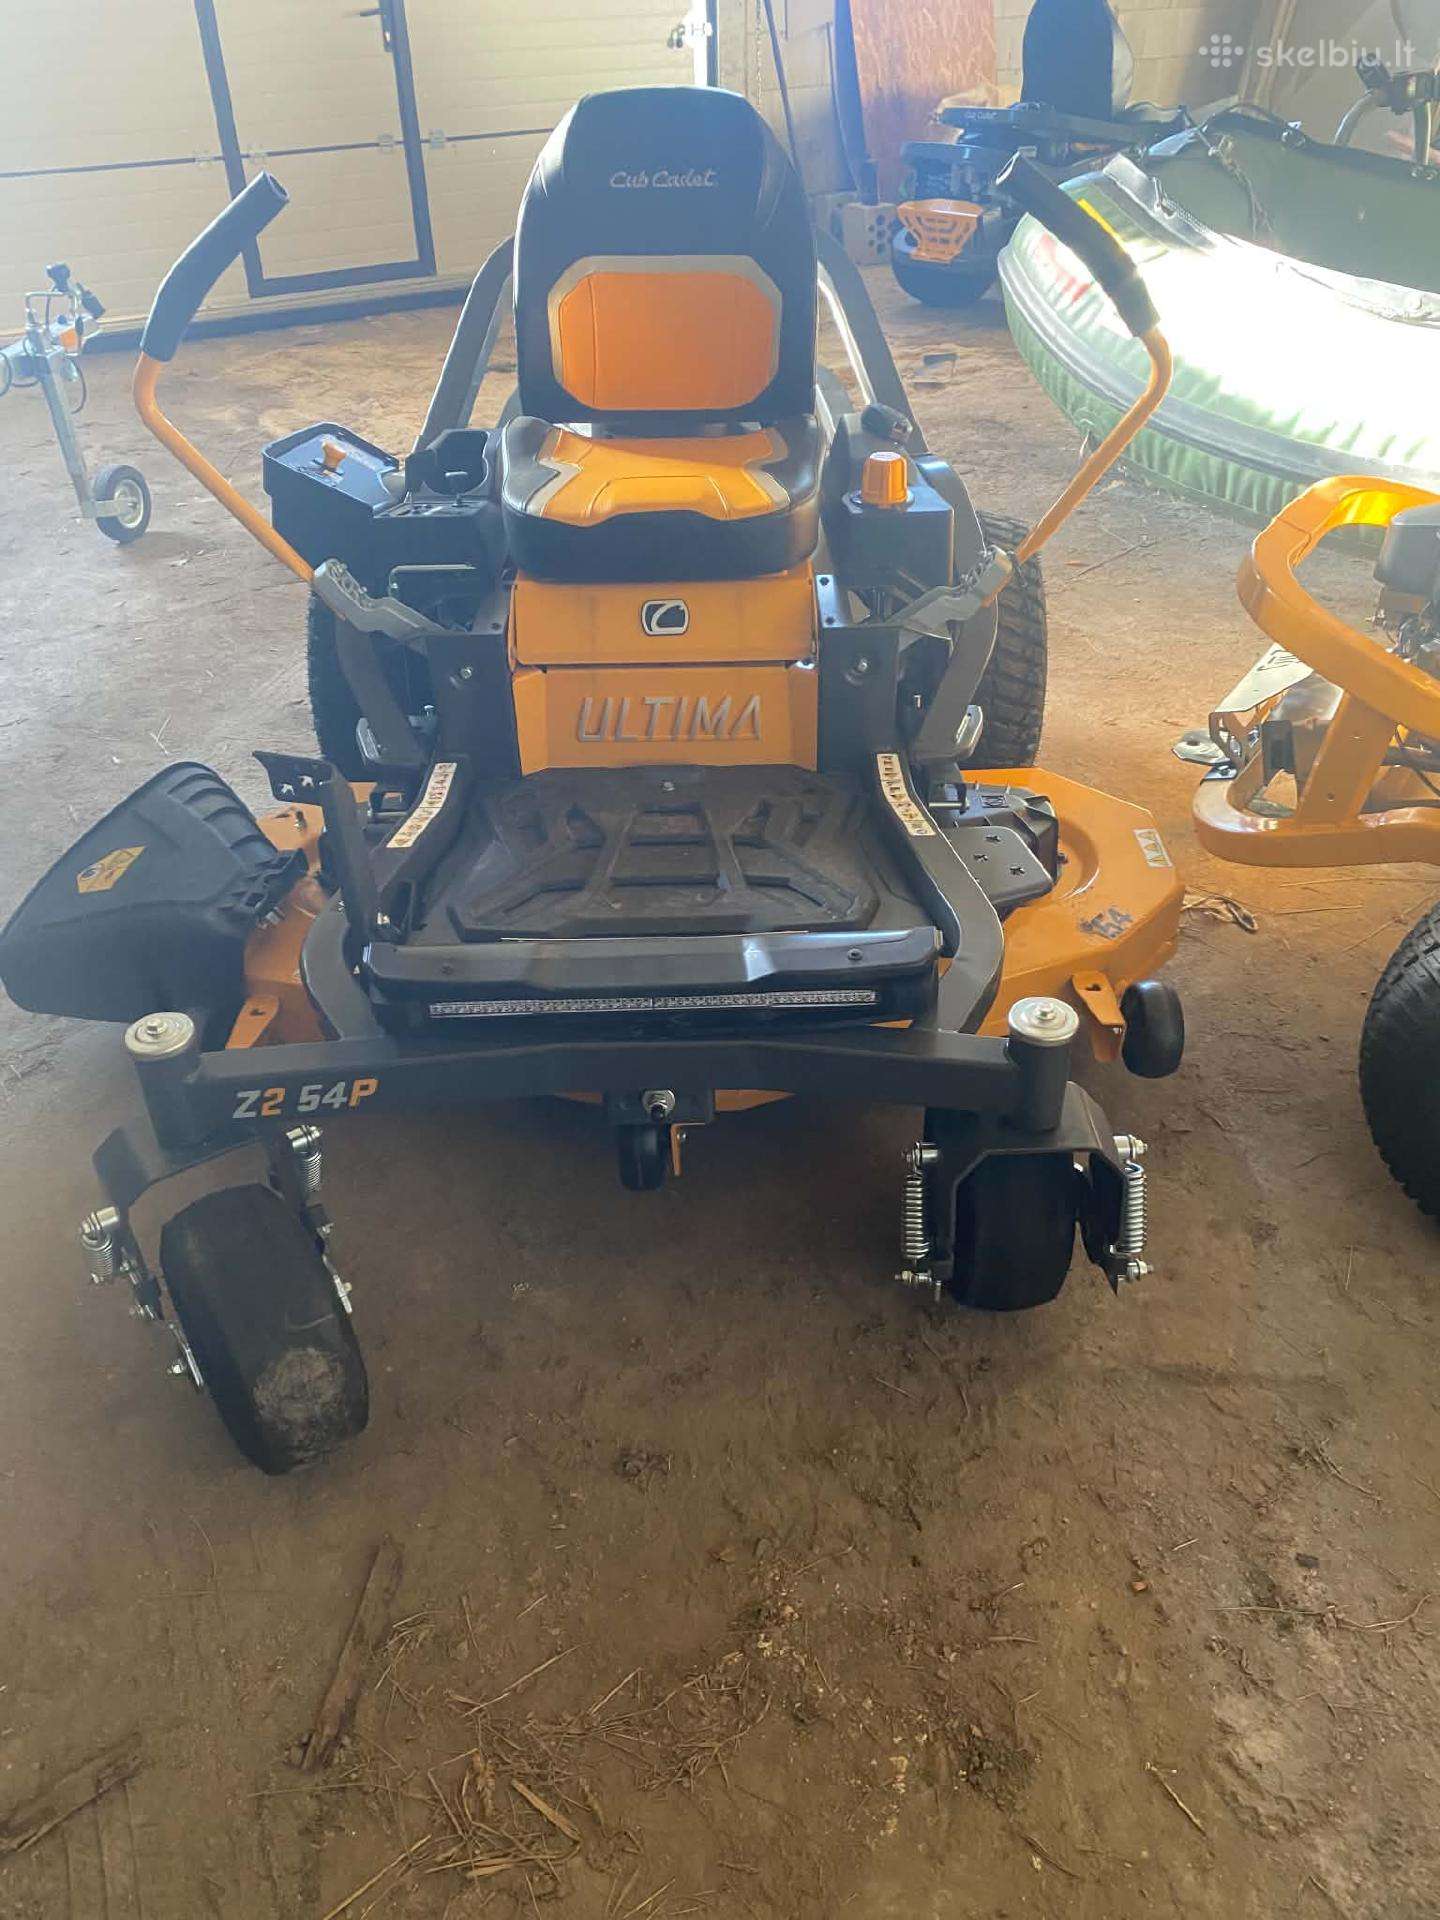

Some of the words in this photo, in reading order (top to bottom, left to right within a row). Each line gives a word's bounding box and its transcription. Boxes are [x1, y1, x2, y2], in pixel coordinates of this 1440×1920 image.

[610, 169, 649, 188] Cub
[652, 168, 717, 188] Cadet
[577, 694, 761, 742] ULTIMA
[232, 1087, 286, 1119] Z2
[297, 1078, 379, 1113] 54P
